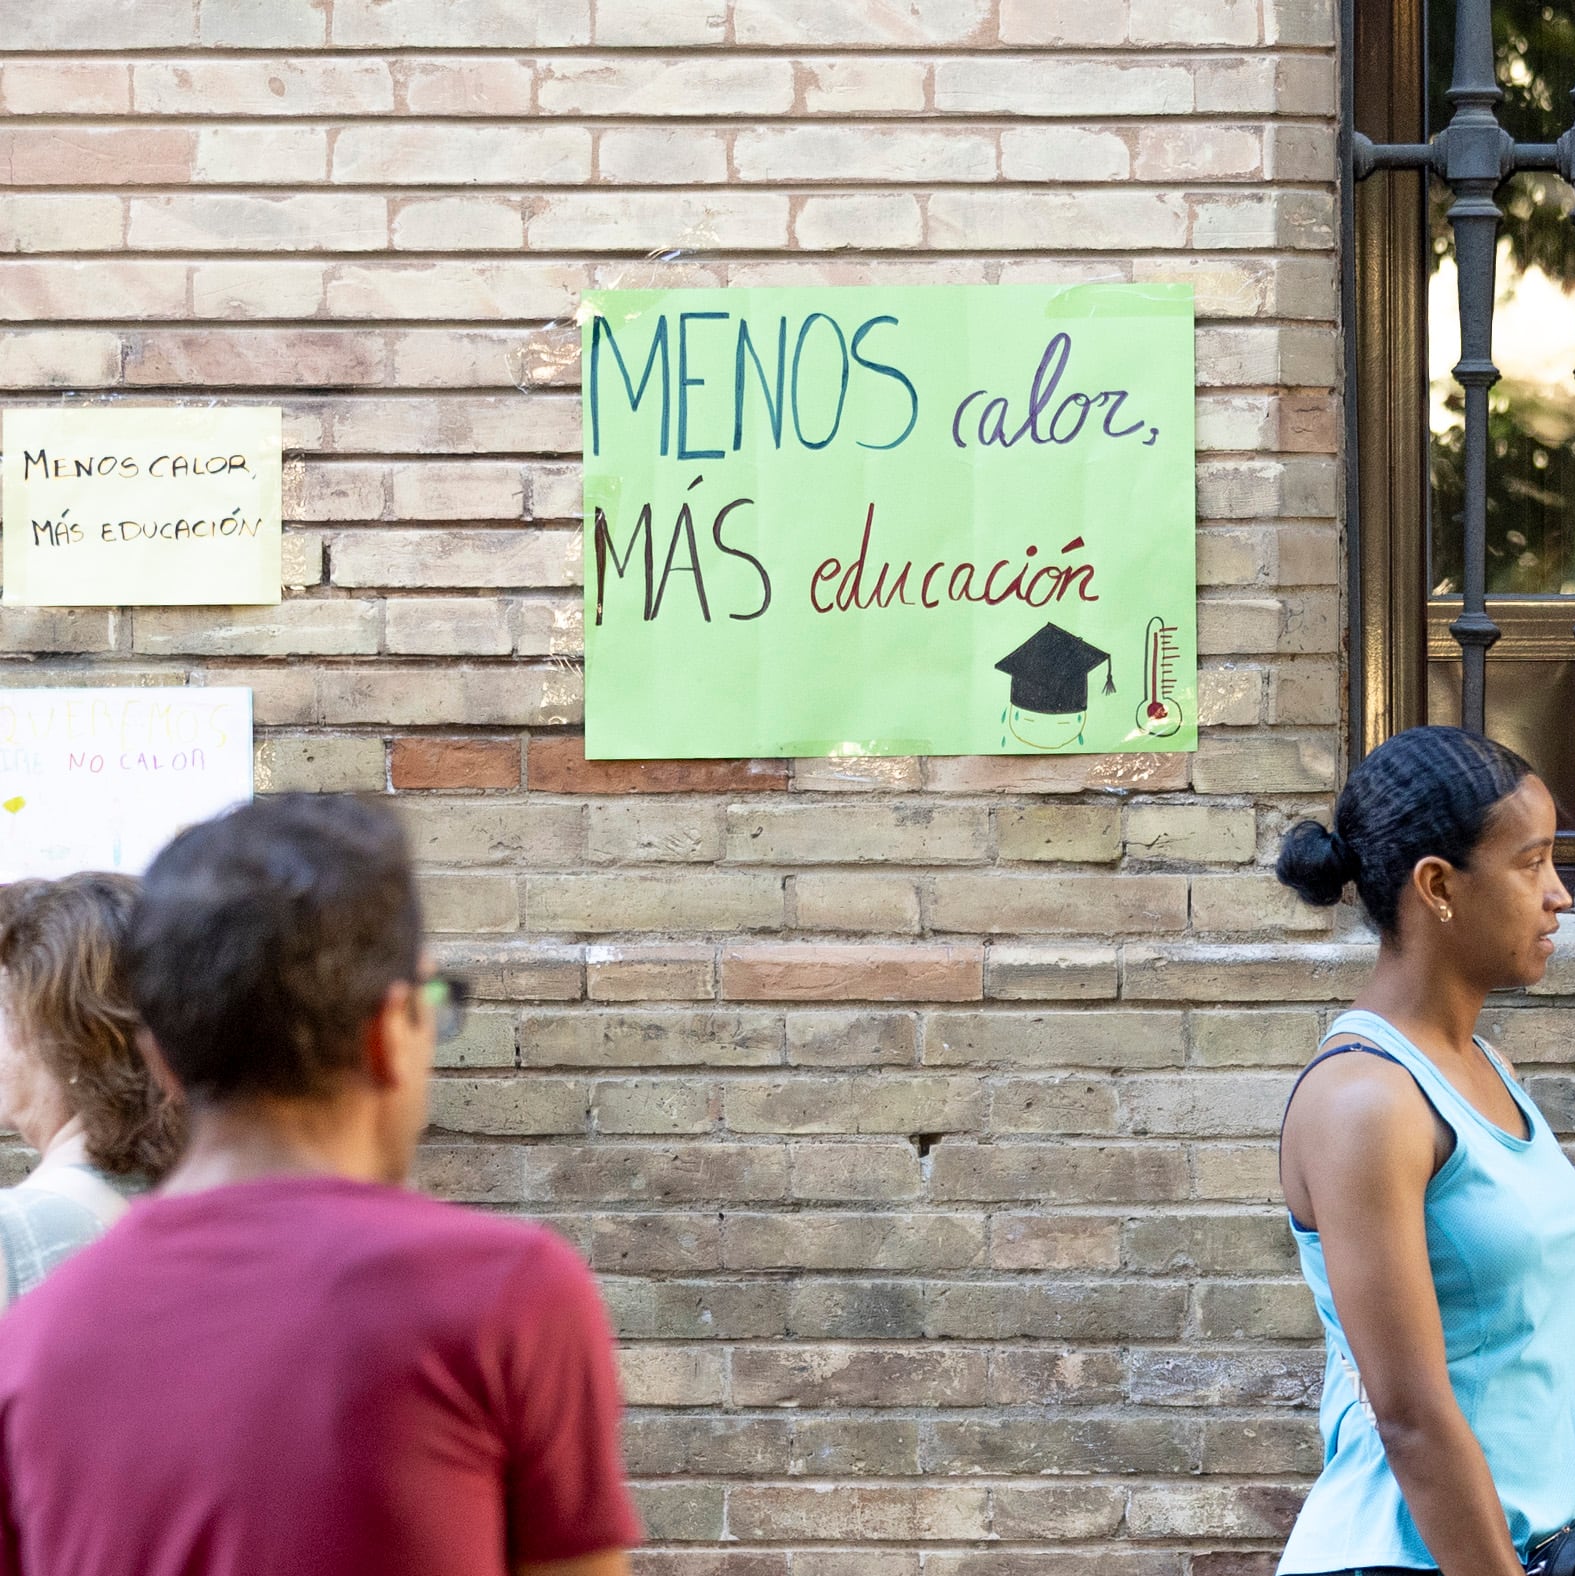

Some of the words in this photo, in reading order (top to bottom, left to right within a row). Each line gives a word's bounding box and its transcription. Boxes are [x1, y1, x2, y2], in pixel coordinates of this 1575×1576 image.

[591, 311, 918, 460] MENOS
[952, 331, 1160, 449] calor,
[23, 449, 139, 480] MENOS
[149, 454, 257, 481] CALOR,
[33, 508, 84, 546] MÁS
[101, 507, 262, 542] EDUCACIÓN
[594, 474, 773, 626] MÁS
[810, 502, 1100, 615] educación
[69, 751, 104, 773] NO
[120, 748, 205, 770] CALOR
